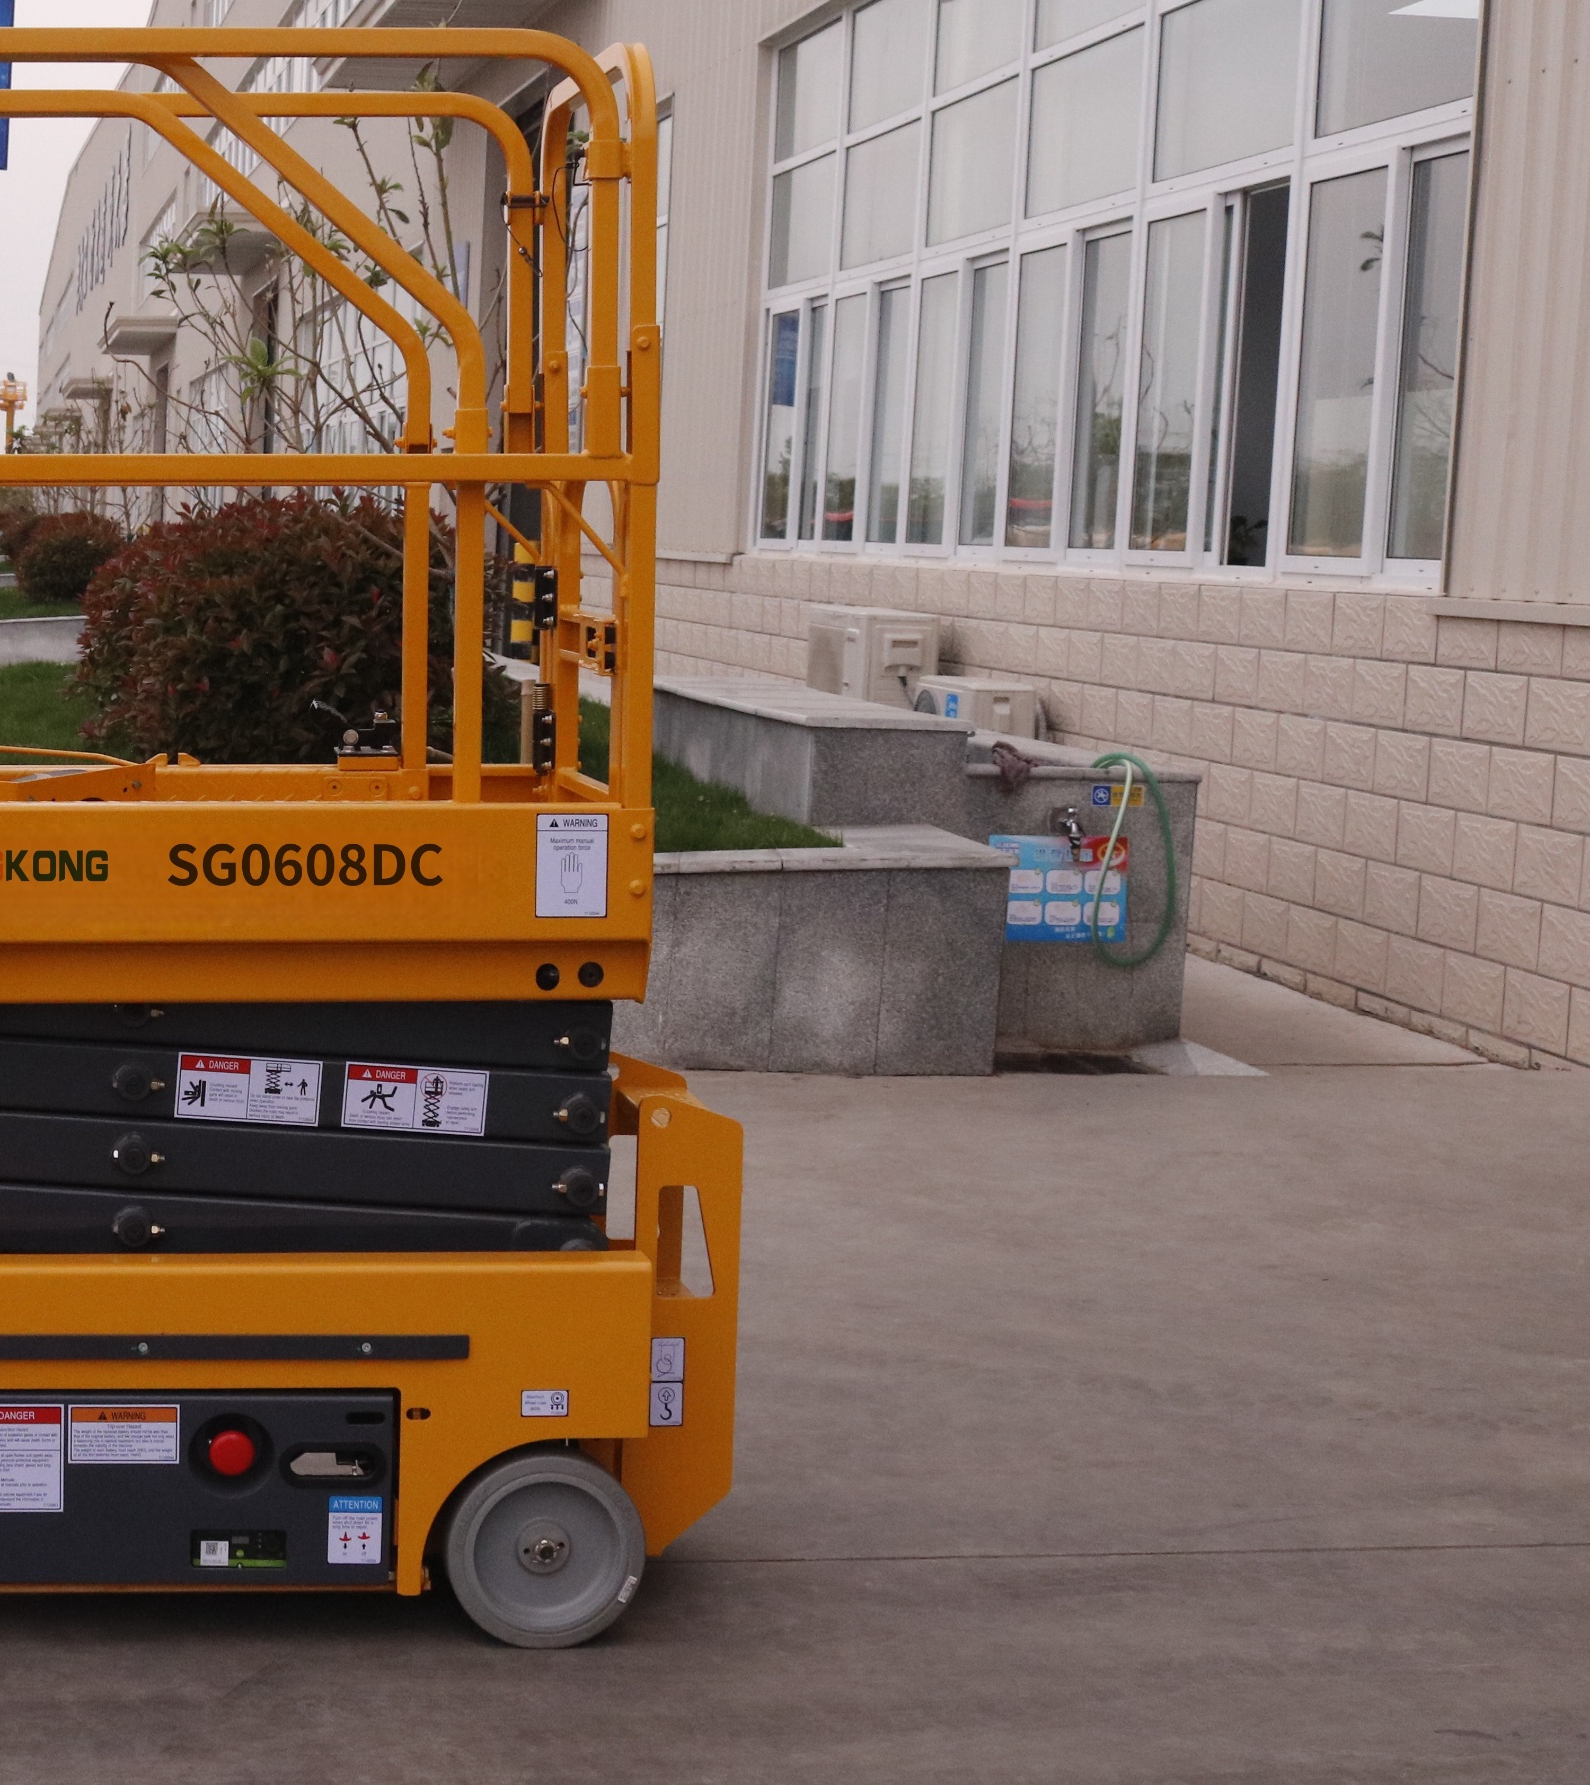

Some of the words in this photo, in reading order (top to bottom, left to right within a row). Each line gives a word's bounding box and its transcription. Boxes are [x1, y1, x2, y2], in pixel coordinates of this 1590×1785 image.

[563, 819, 598, 827] WARNING
[168, 843, 443, 886] SG0608DC
[209, 1061, 239, 1070] DANGER
[376, 1070, 406, 1080] DANGER
[112, 1412, 146, 1420] WARNING
[333, 1500, 378, 1509] ATTENTION
